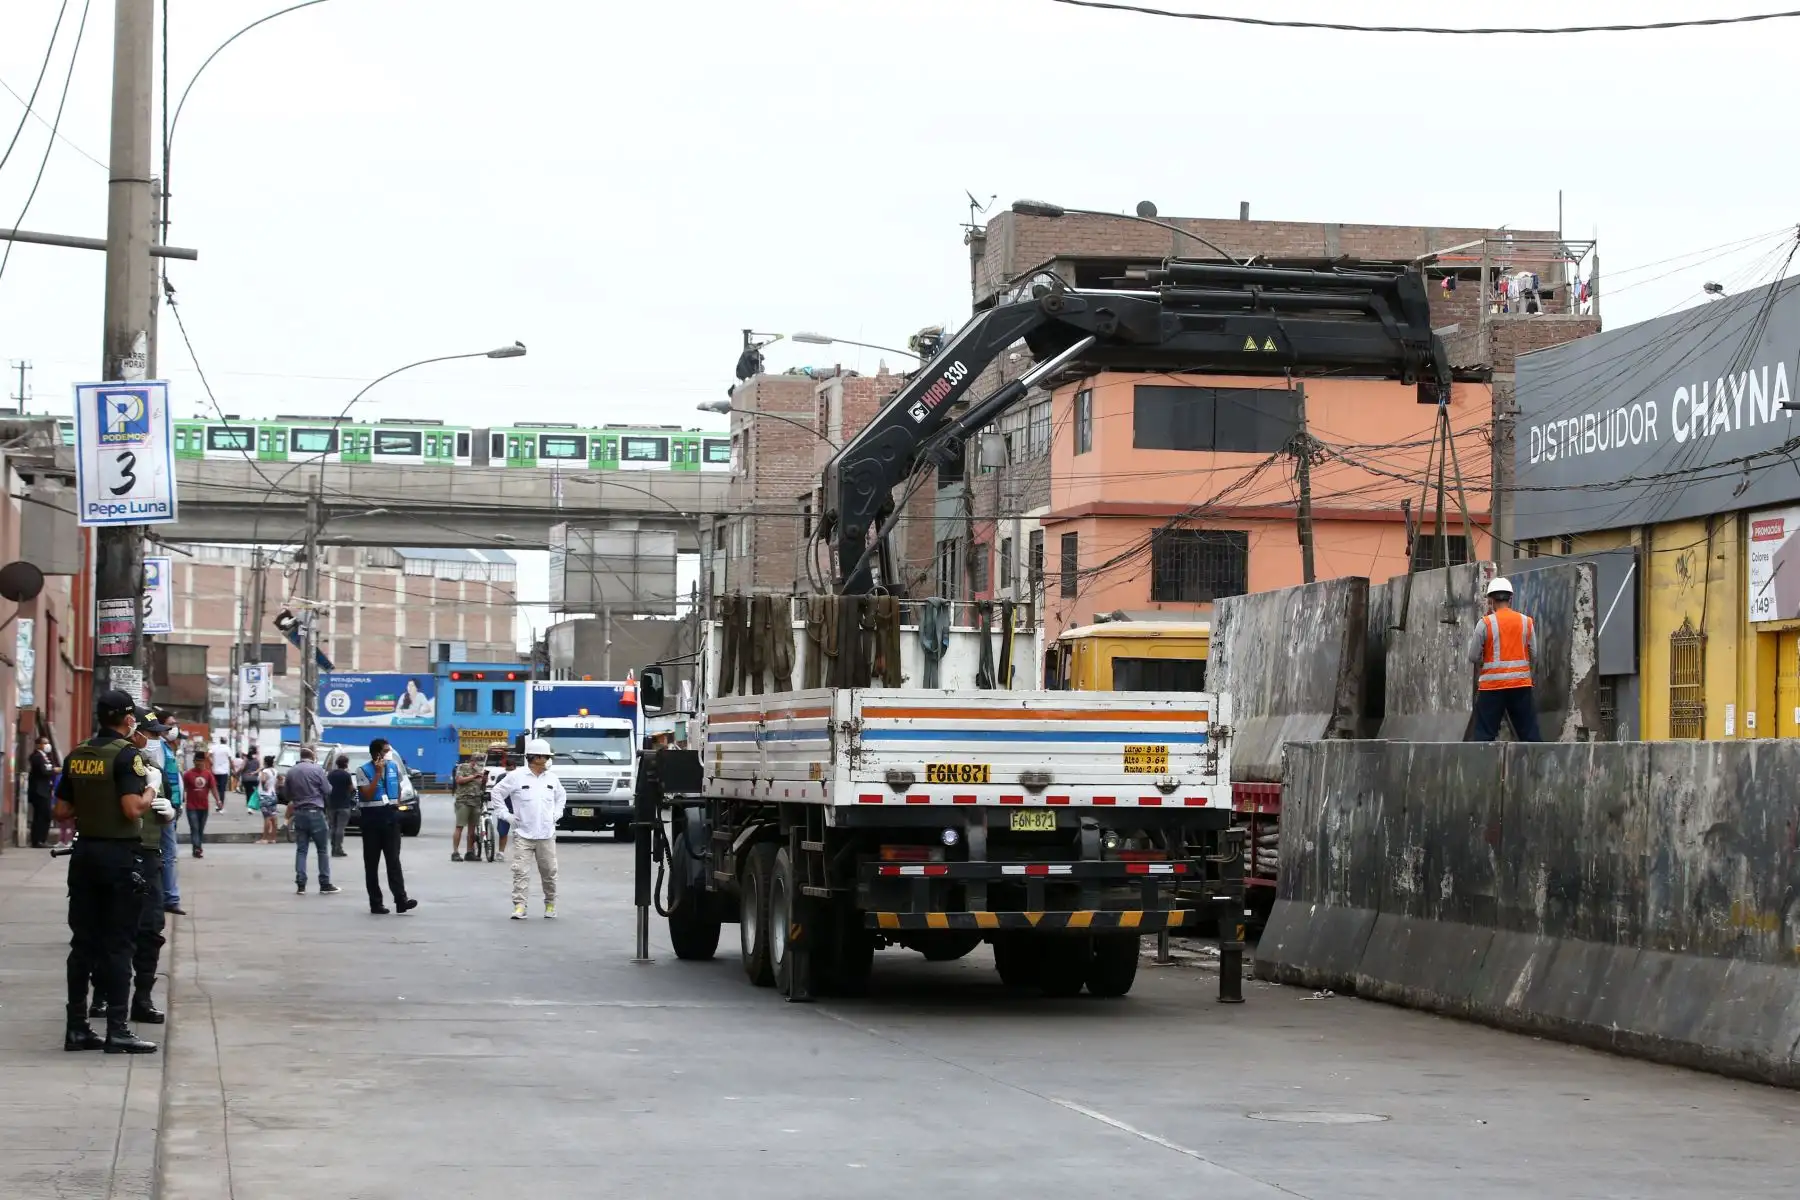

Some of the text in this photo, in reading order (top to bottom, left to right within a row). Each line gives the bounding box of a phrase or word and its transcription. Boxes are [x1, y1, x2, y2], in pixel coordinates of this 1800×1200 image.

[921, 361, 968, 409] HIAB 330
[1530, 361, 1793, 464] DISTRIBUIDOR CHAYNA
[102, 432, 146, 442] PODEMOS
[109, 451, 136, 496] 3
[88, 501, 167, 517] Pepe Luna
[1751, 552, 1769, 562] Colores
[1755, 597, 1770, 613] 149
[330, 697, 345, 708] 02
[1012, 812, 1055, 828] F6N-871
